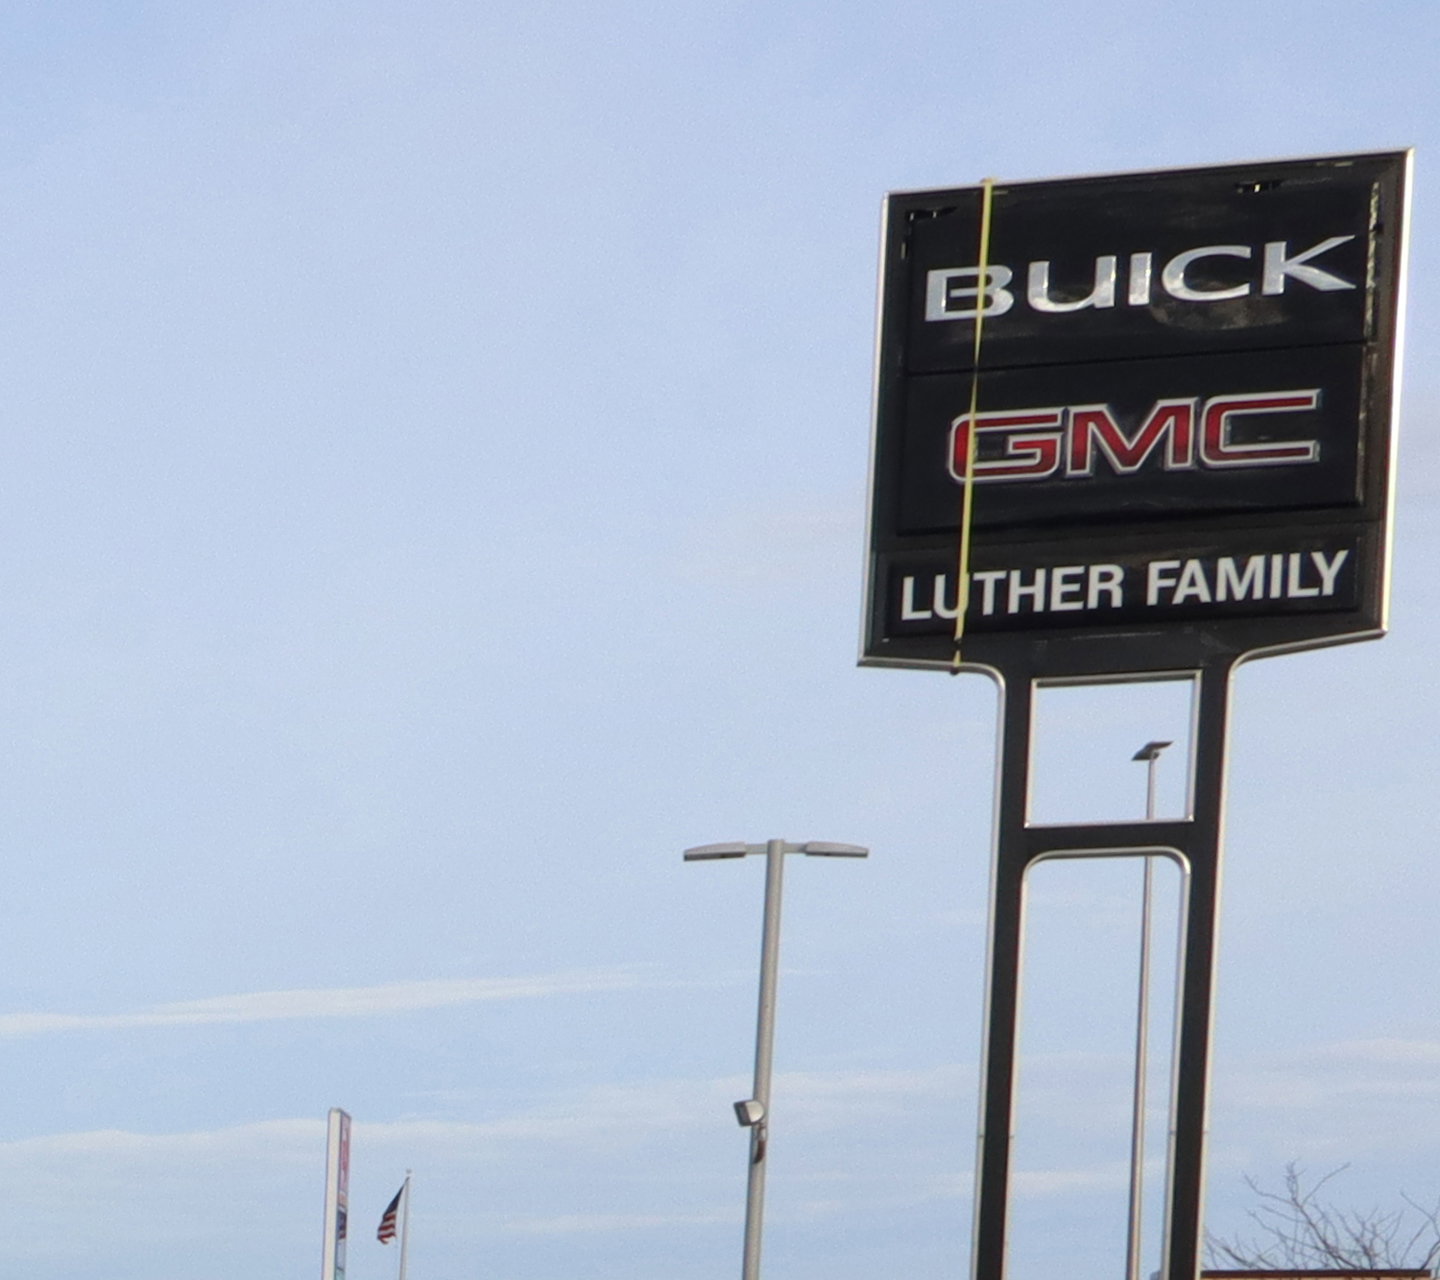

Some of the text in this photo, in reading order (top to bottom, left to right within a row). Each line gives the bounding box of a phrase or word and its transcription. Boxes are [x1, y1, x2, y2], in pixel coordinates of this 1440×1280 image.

[925, 234, 1356, 322] BUICK
[946, 388, 1322, 483] GMC
[899, 549, 1348, 622] LUTHER FAMILY
